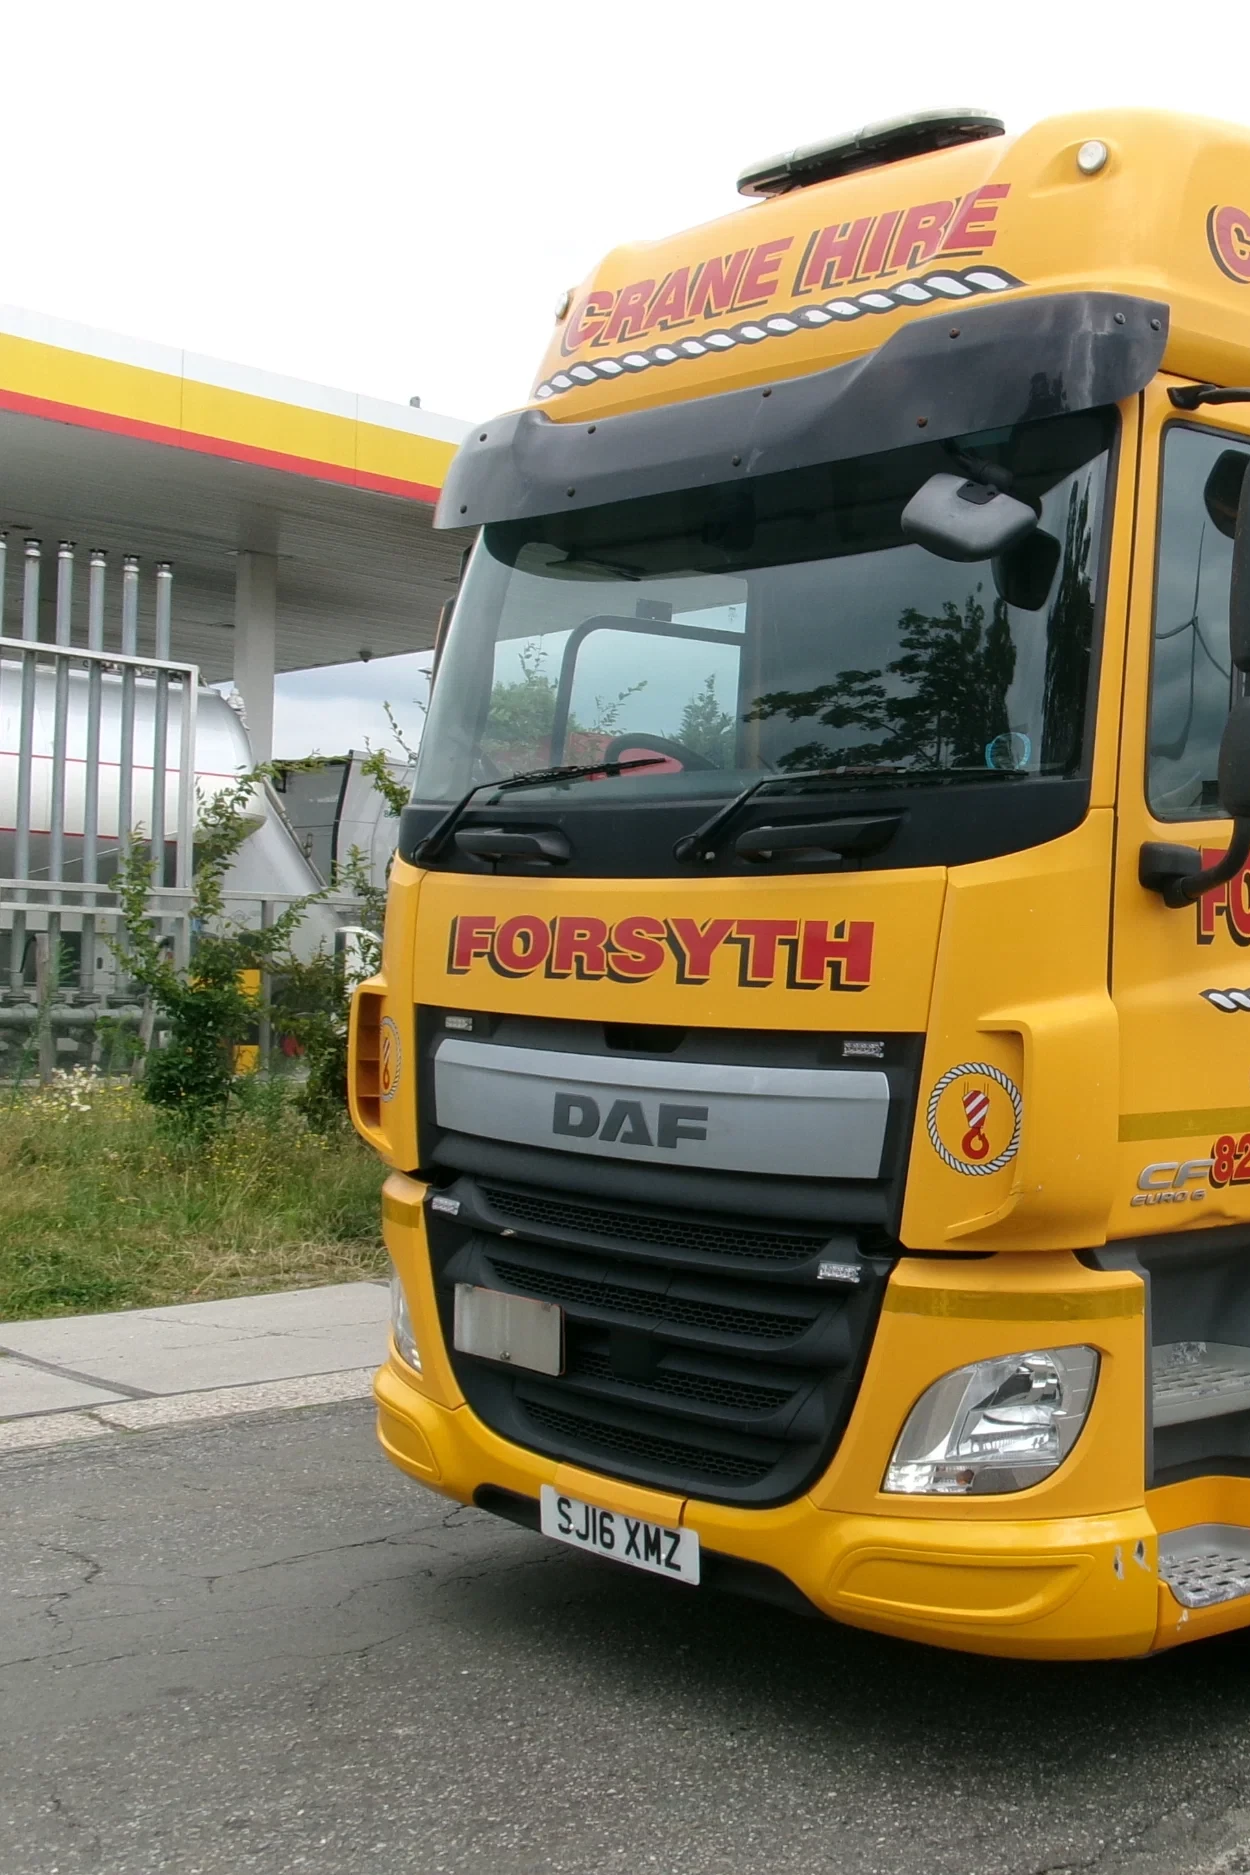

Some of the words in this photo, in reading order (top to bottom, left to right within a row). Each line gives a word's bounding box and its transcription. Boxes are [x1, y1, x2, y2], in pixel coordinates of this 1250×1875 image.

[561, 235, 794, 357] CRANE
[791, 182, 1011, 297] HIRE
[446, 914, 876, 993] FORSYTH
[552, 1091, 709, 1149] DAF
[1130, 1190, 1188, 1207] EURO
[1189, 1188, 1207, 1201] 6
[1137, 1157, 1215, 1190] CF
[557, 1496, 615, 1550] SJ16
[624, 1517, 682, 1573] XMZ
